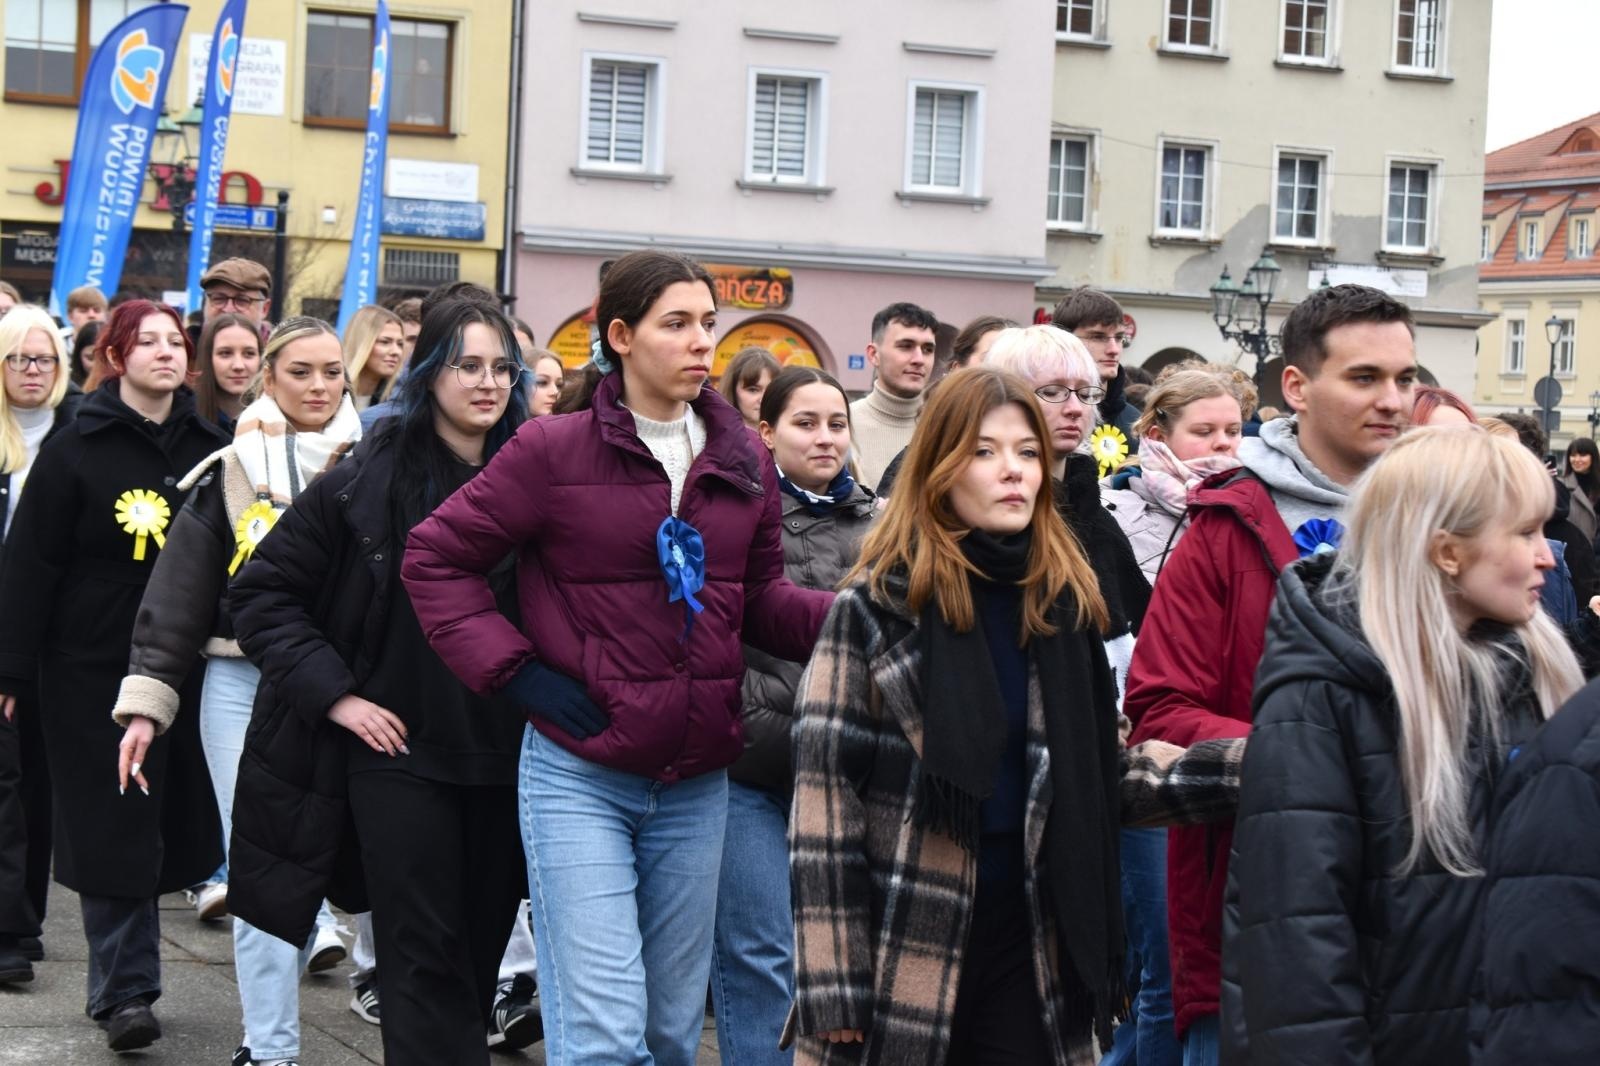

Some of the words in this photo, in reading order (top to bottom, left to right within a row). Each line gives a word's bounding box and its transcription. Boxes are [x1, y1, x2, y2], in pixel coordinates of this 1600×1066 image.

[84, 123, 131, 288] WODZISŁAW
[115, 124, 148, 218] POWIAT
[715, 273, 784, 304] AŃCZA
